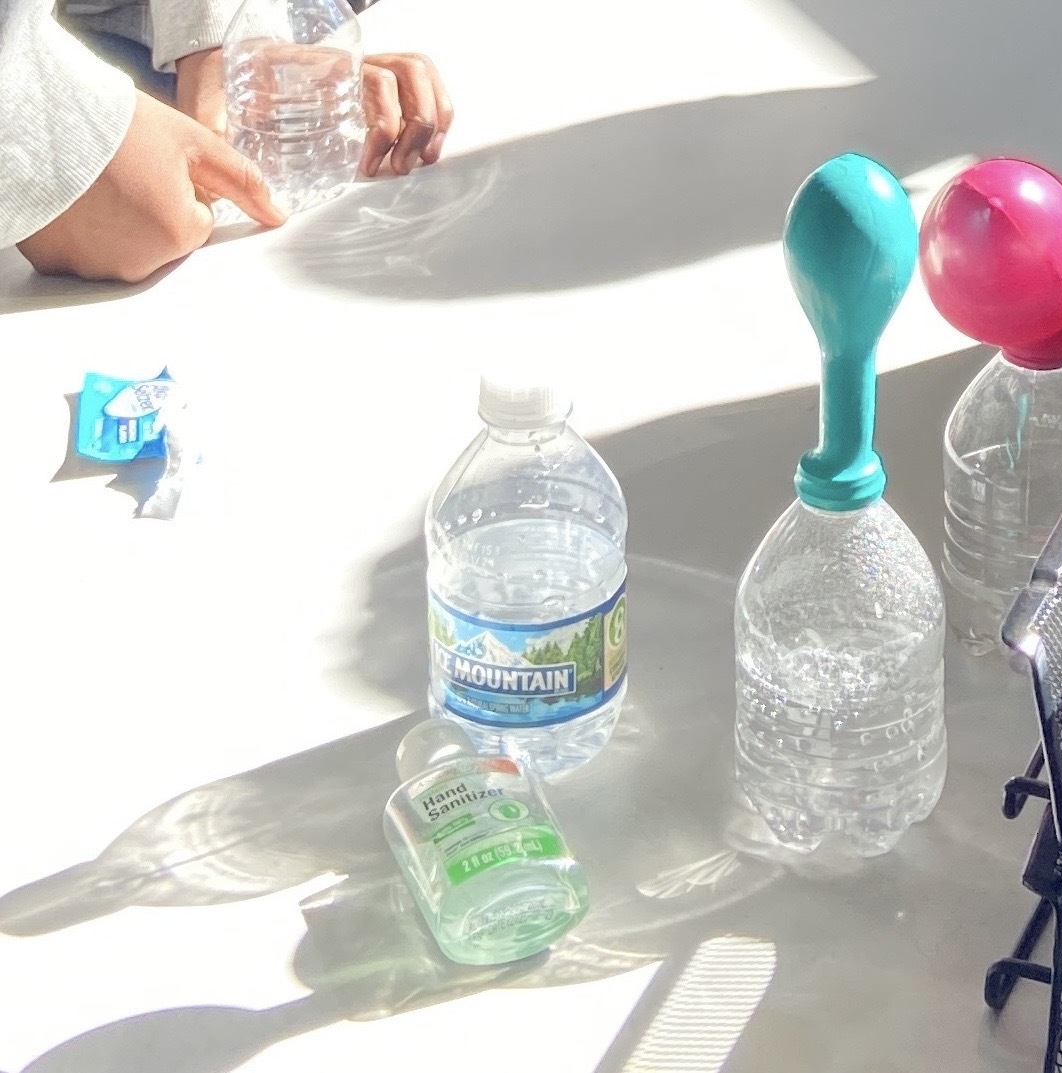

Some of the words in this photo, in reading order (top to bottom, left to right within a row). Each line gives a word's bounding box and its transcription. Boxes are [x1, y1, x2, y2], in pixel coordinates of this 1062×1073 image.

[454, 658, 569, 691] MOUNTAIN
[422, 782, 468, 811] Hand
[428, 787, 504, 822] Sanitizer
[461, 859, 473, 873] 2
[481, 851, 495, 864] oz
